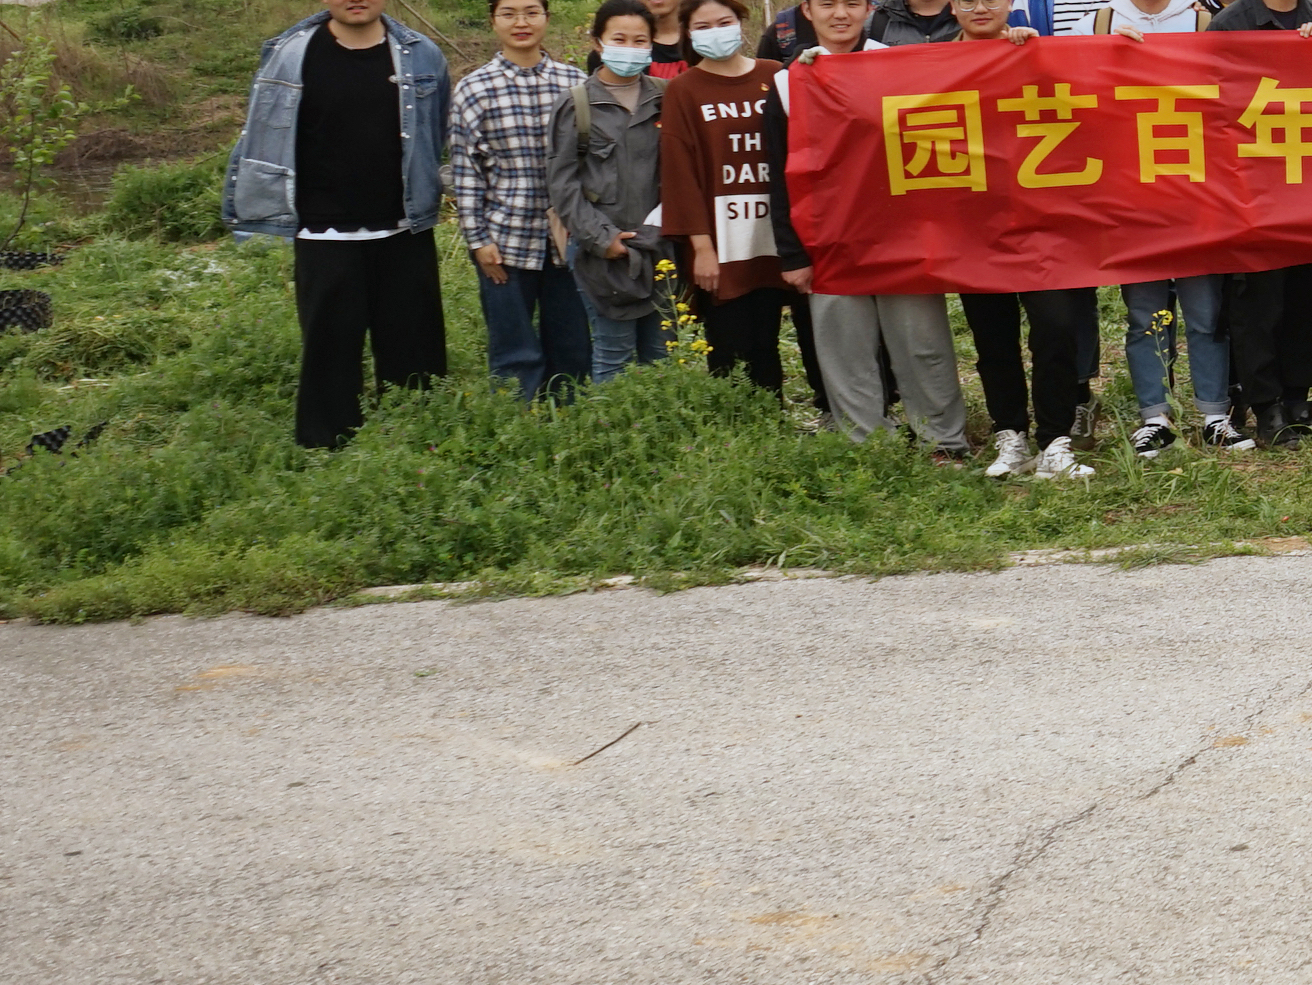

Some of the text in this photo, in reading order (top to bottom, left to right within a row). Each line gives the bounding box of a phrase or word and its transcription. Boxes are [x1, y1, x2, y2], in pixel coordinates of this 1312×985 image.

[701, 99, 767, 122] ENJ
[729, 132, 762, 152] TH
[722, 163, 771, 185] DAR
[727, 201, 770, 220] SID
